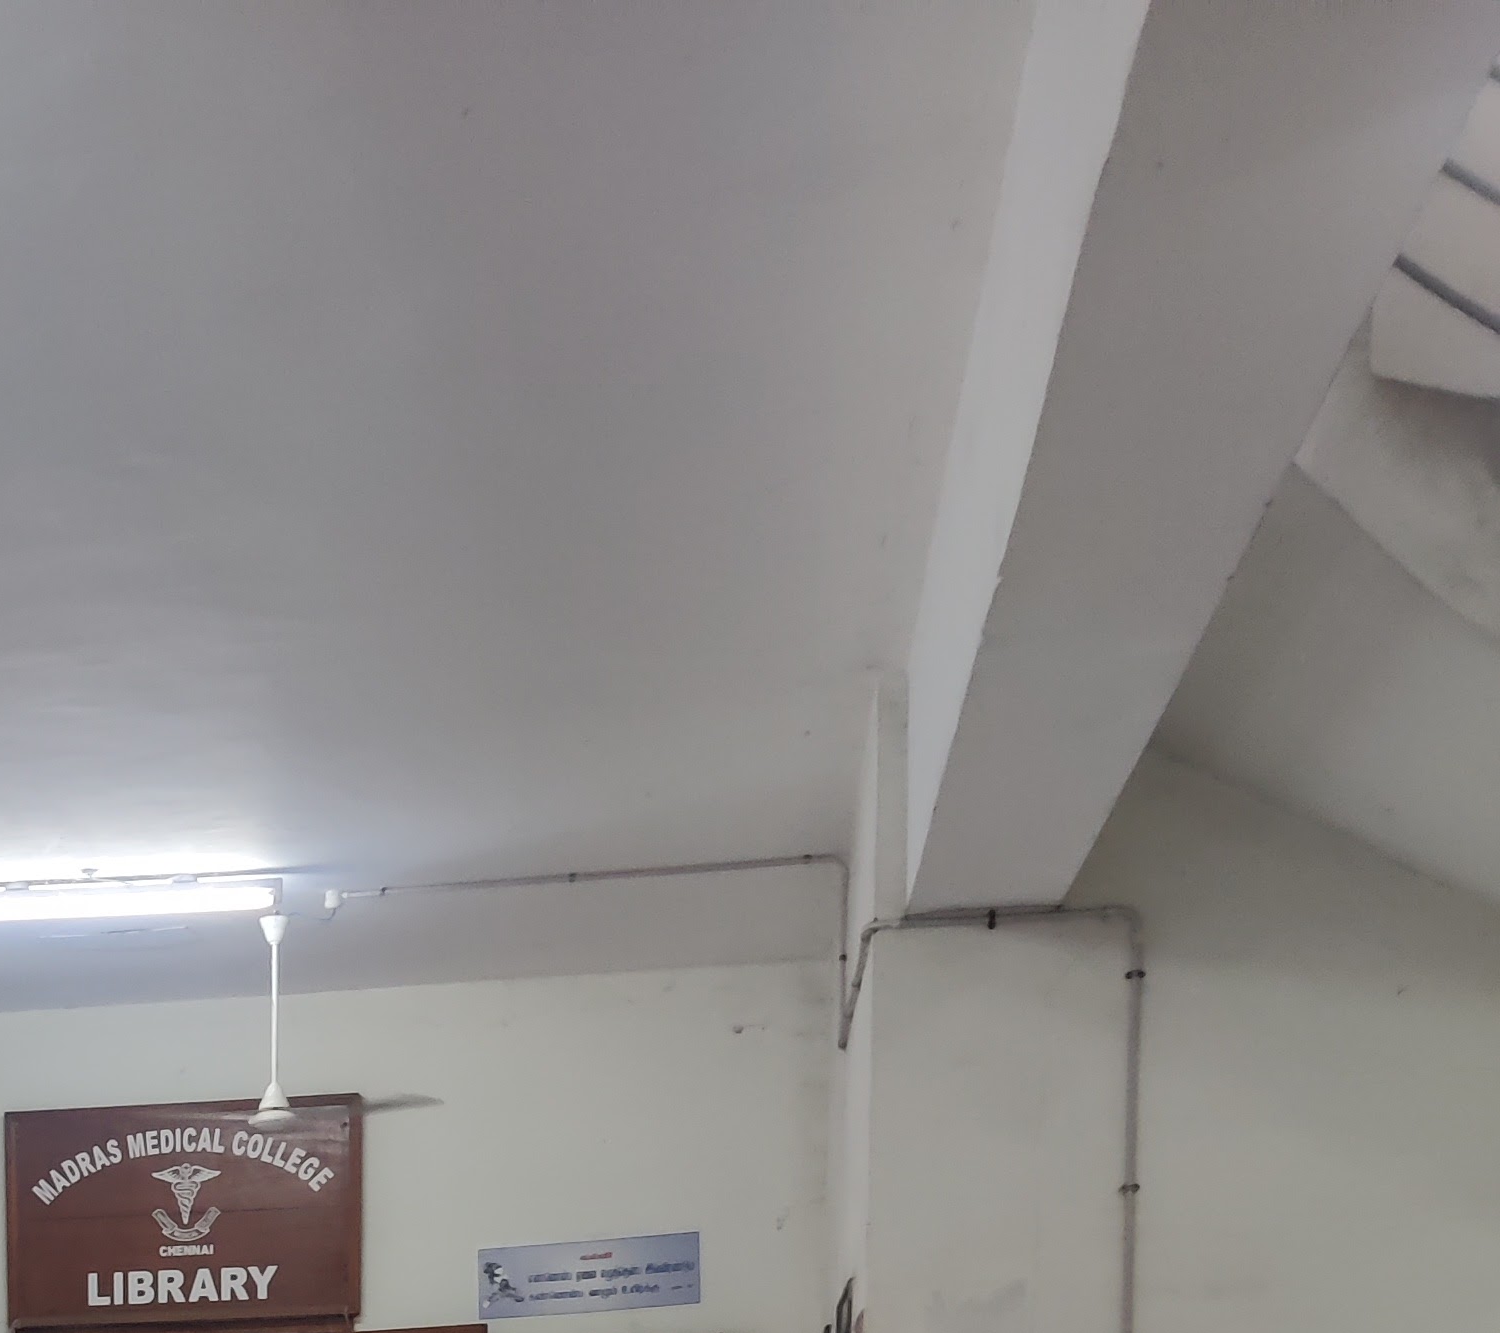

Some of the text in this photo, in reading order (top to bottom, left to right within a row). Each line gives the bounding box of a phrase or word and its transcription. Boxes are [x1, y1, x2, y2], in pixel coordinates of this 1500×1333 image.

[31, 1127, 335, 1206] MADRAS MEDICAL COLLEGE
[158, 1244, 215, 1257] CHENNAI
[87, 1265, 279, 1306] LIBRARY
